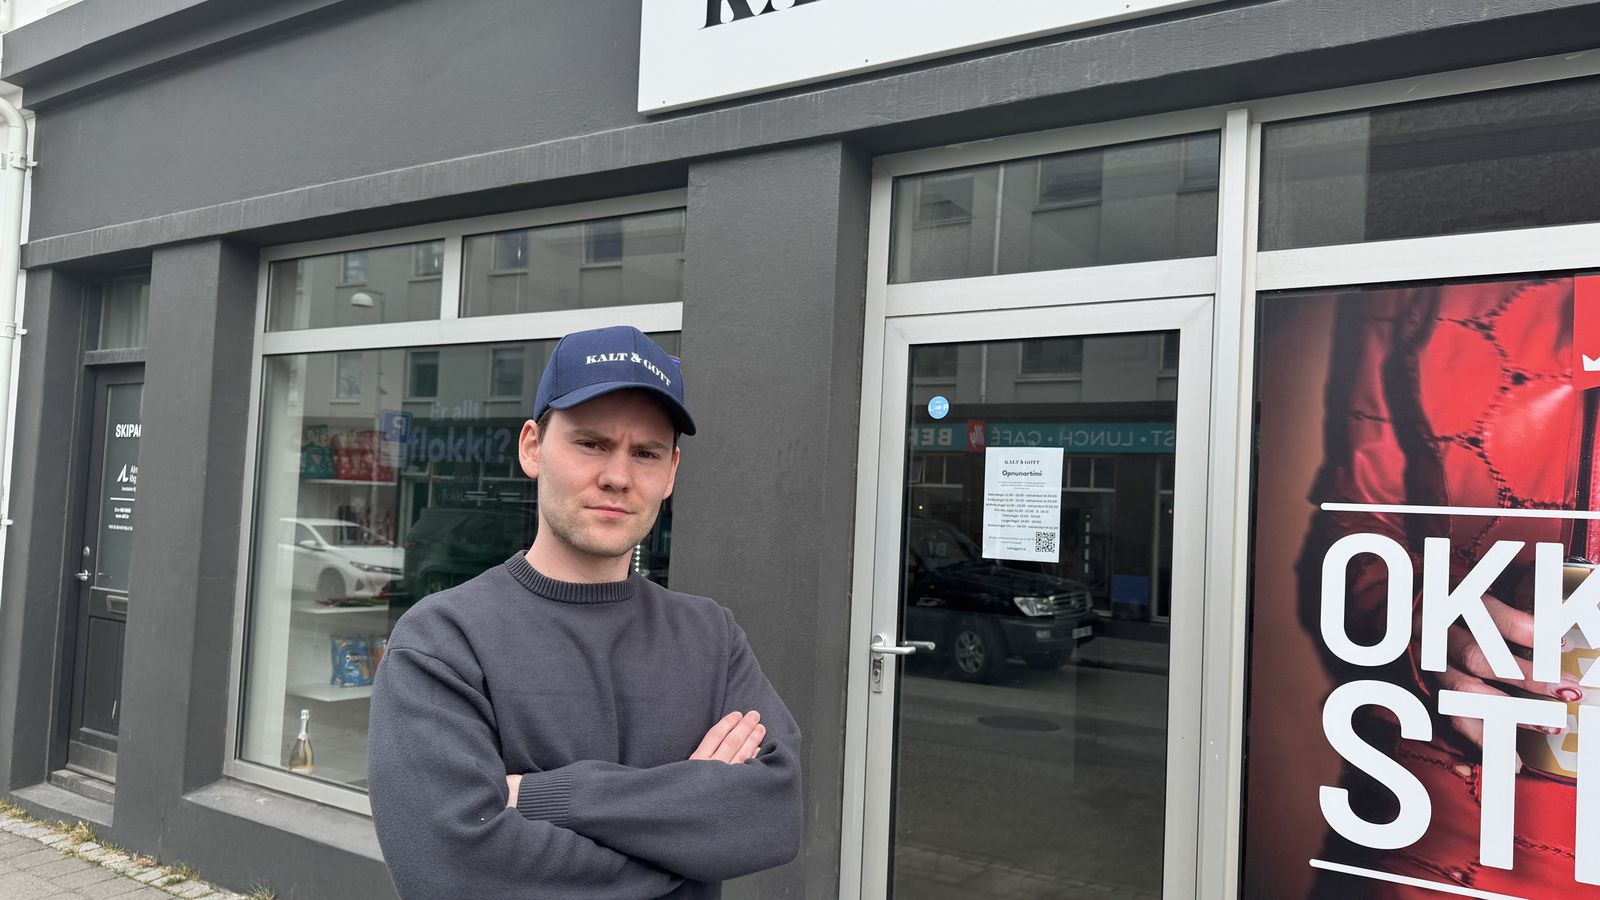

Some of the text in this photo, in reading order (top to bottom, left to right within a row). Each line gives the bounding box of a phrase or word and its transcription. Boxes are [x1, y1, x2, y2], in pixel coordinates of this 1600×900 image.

[586, 352, 672, 387] KALT & GOTT
